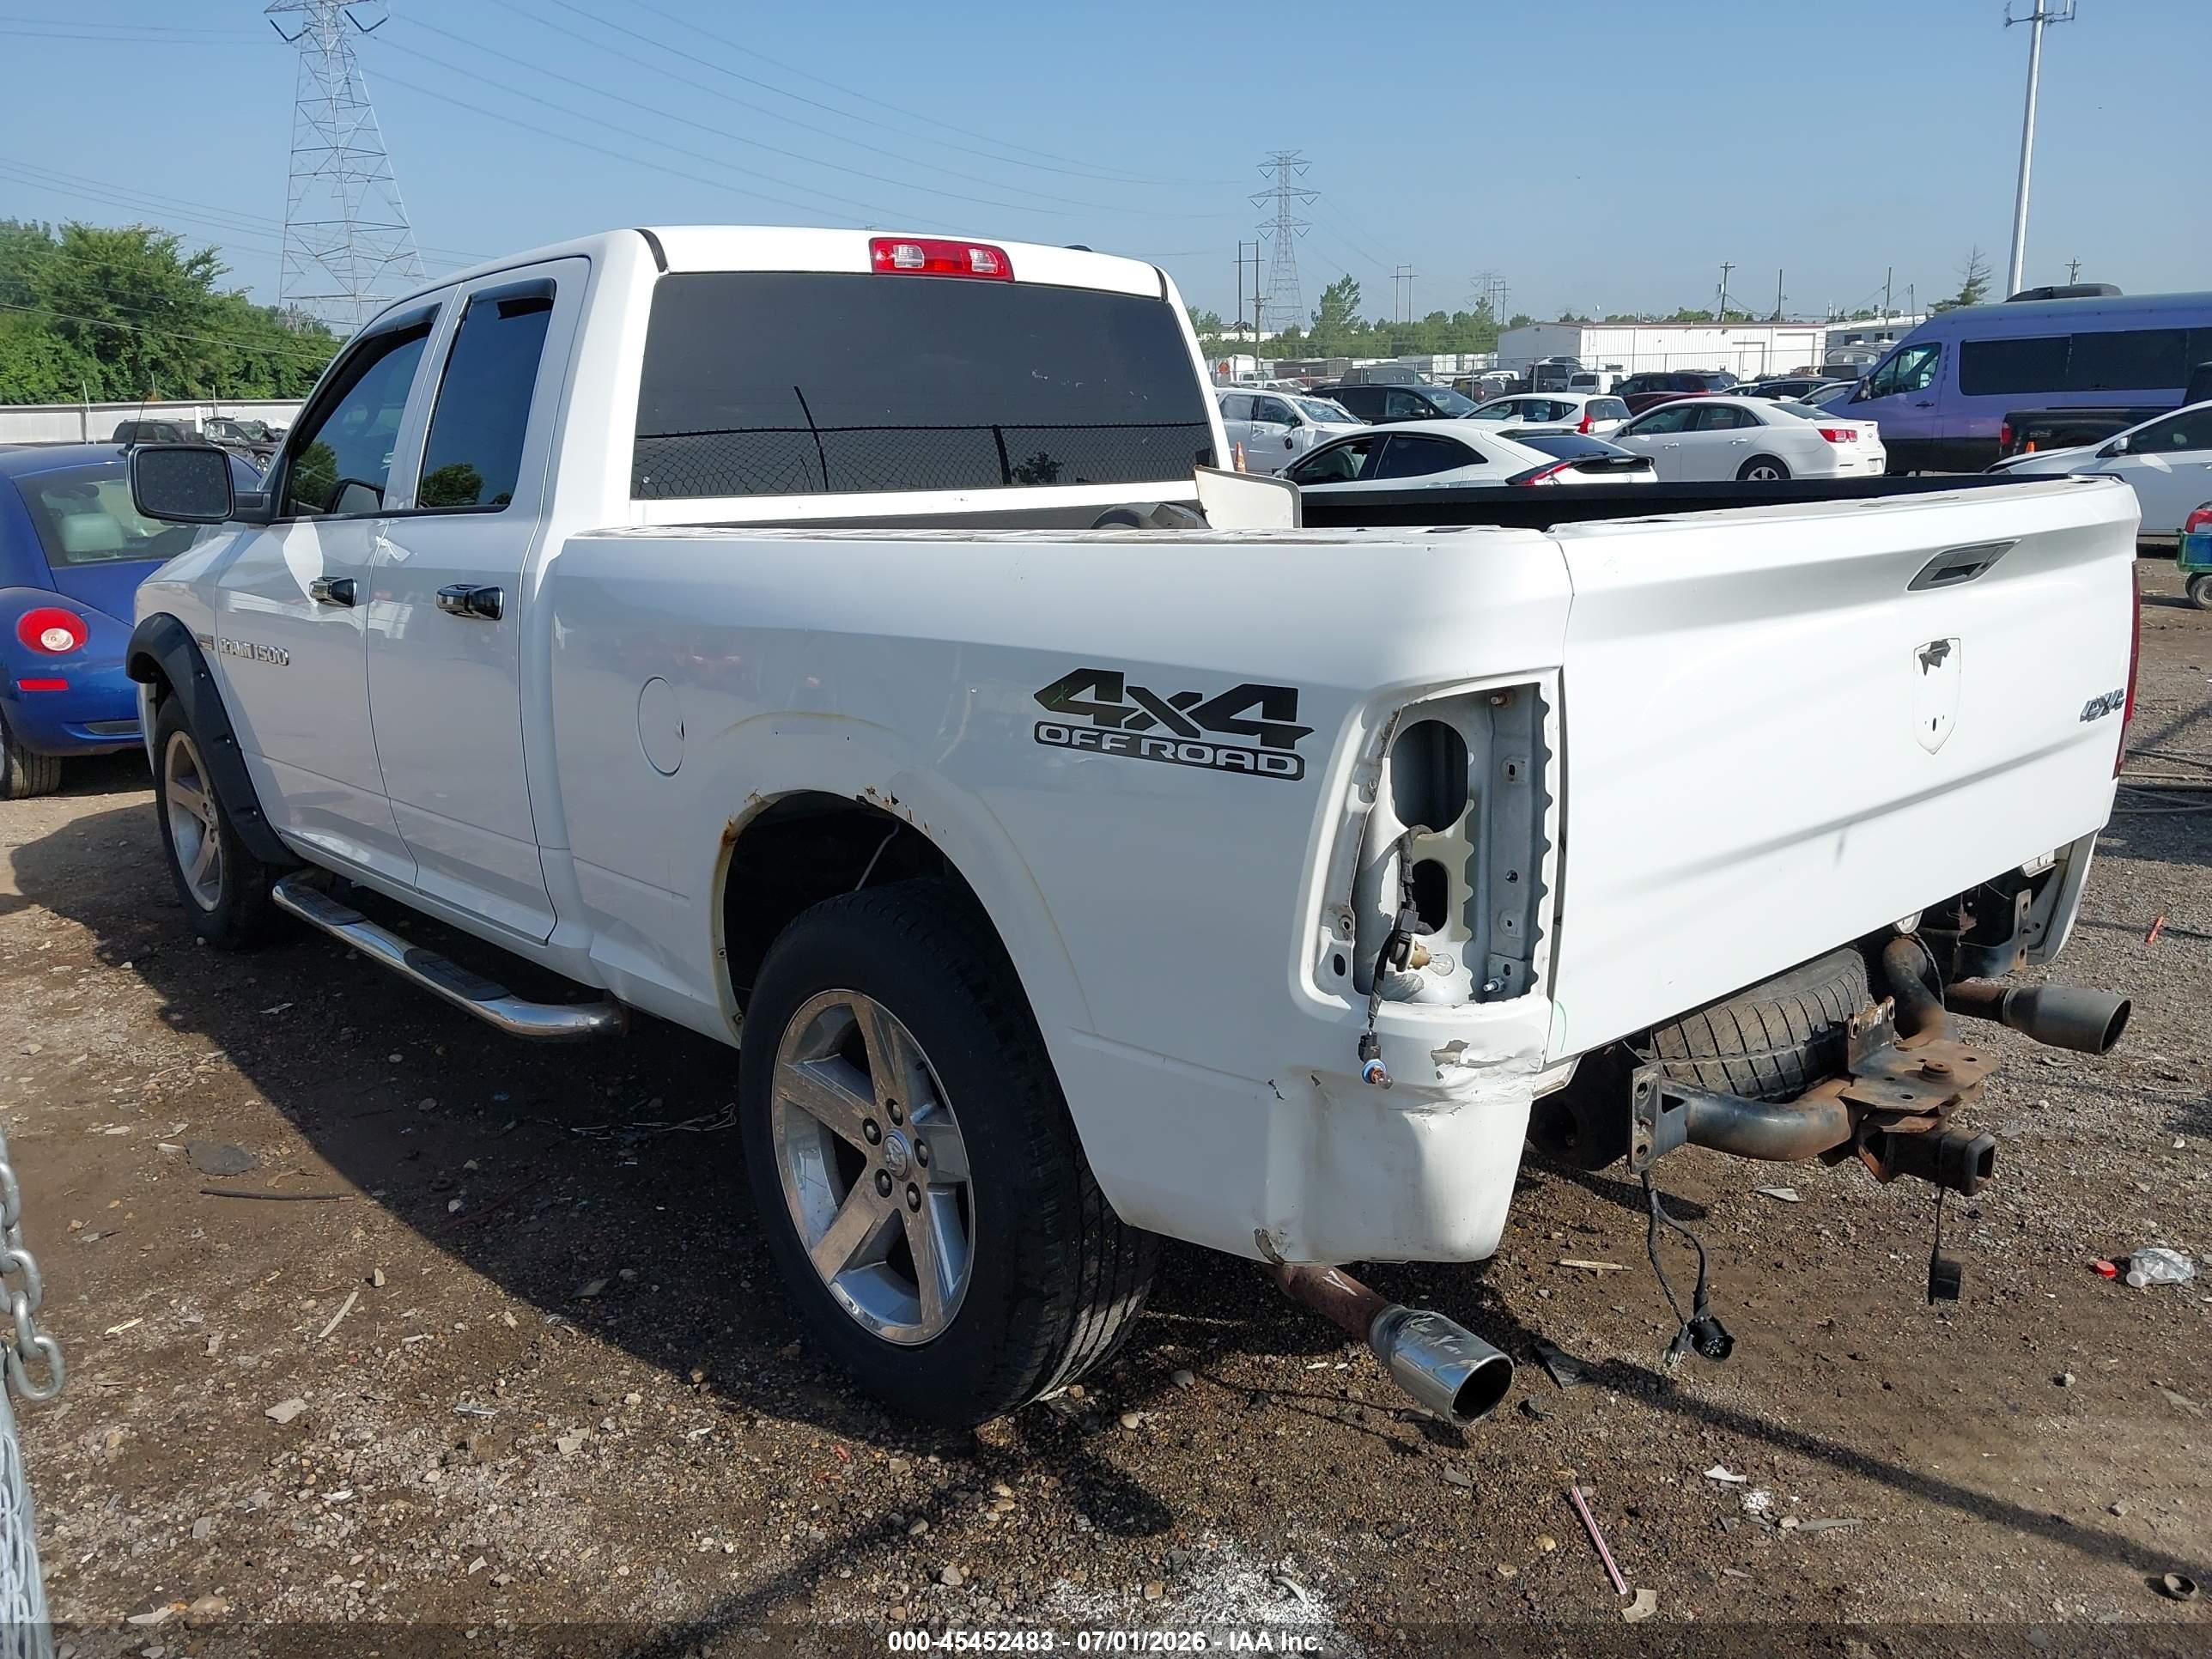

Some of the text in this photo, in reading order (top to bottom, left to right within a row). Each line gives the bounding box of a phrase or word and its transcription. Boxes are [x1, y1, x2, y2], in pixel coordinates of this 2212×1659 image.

[219, 637, 254, 660] RAM
[253, 643, 290, 666] 1500
[1037, 723, 1298, 775] OFF ROAD
